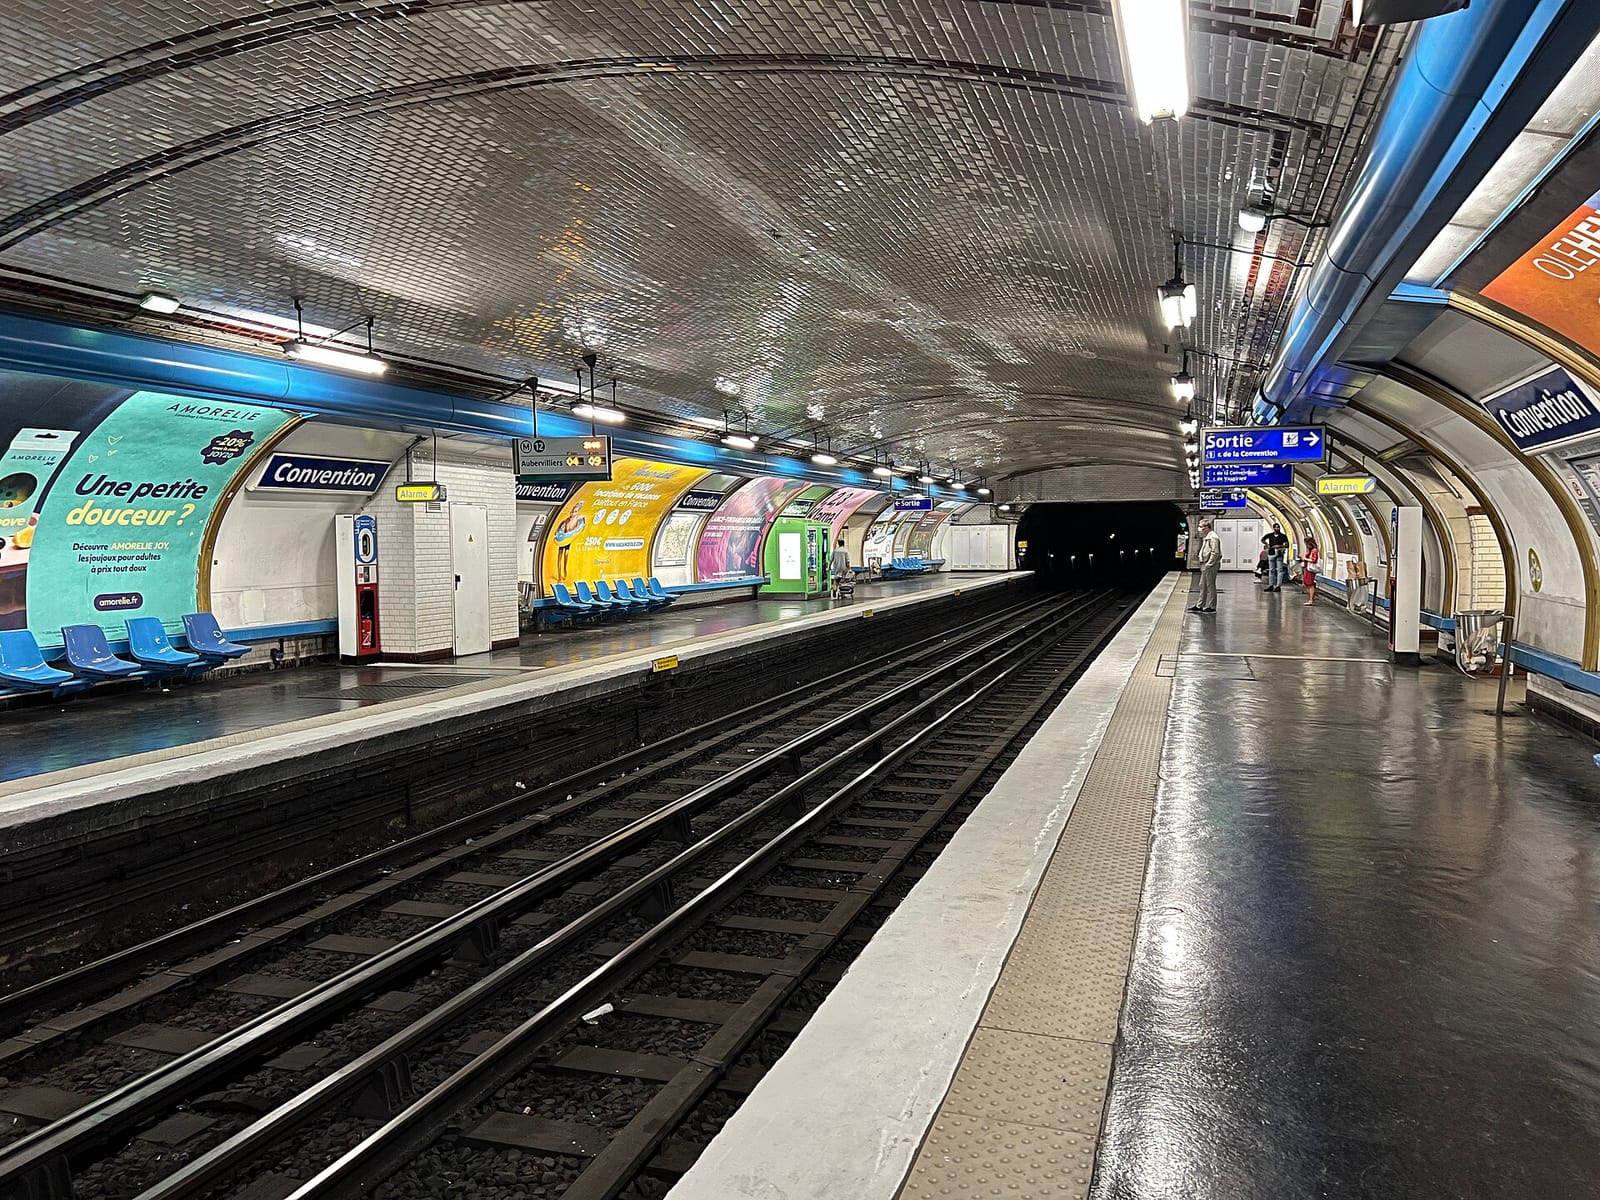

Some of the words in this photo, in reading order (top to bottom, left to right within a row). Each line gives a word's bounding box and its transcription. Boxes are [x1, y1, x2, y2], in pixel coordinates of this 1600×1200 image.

[166, 403, 261, 421] AMORELIE
[1500, 388, 1592, 438] Convention
[534, 442, 544, 451] 12
[1206, 434, 1253, 448] Sortie
[1240, 449, 1278, 457] Convention
[521, 459, 563, 467] Aubervilliers
[566, 456, 580, 467] 04
[588, 456, 602, 467] 09
[274, 462, 376, 487] Convention
[75, 473, 132, 497] Une
[127, 478, 208, 503] petite
[515, 482, 567, 500] onvention
[1323, 482, 1358, 491] Alarme
[400, 489, 428, 499] Alarme
[683, 494, 719, 507] Convention
[66, 500, 176, 526] douceur
[176, 503, 196, 526] ?
[73, 543, 109, 551] Découvre
[111, 542, 153, 550] AMORELIE
[78, 554, 89, 562] les
[88, 555, 116, 563] joujoux
[117, 555, 135, 563] pour
[135, 553, 161, 561] adultes
[97, 565, 112, 575] prix
[129, 564, 147, 572] doux
[99, 595, 138, 607] amorelie.fr
